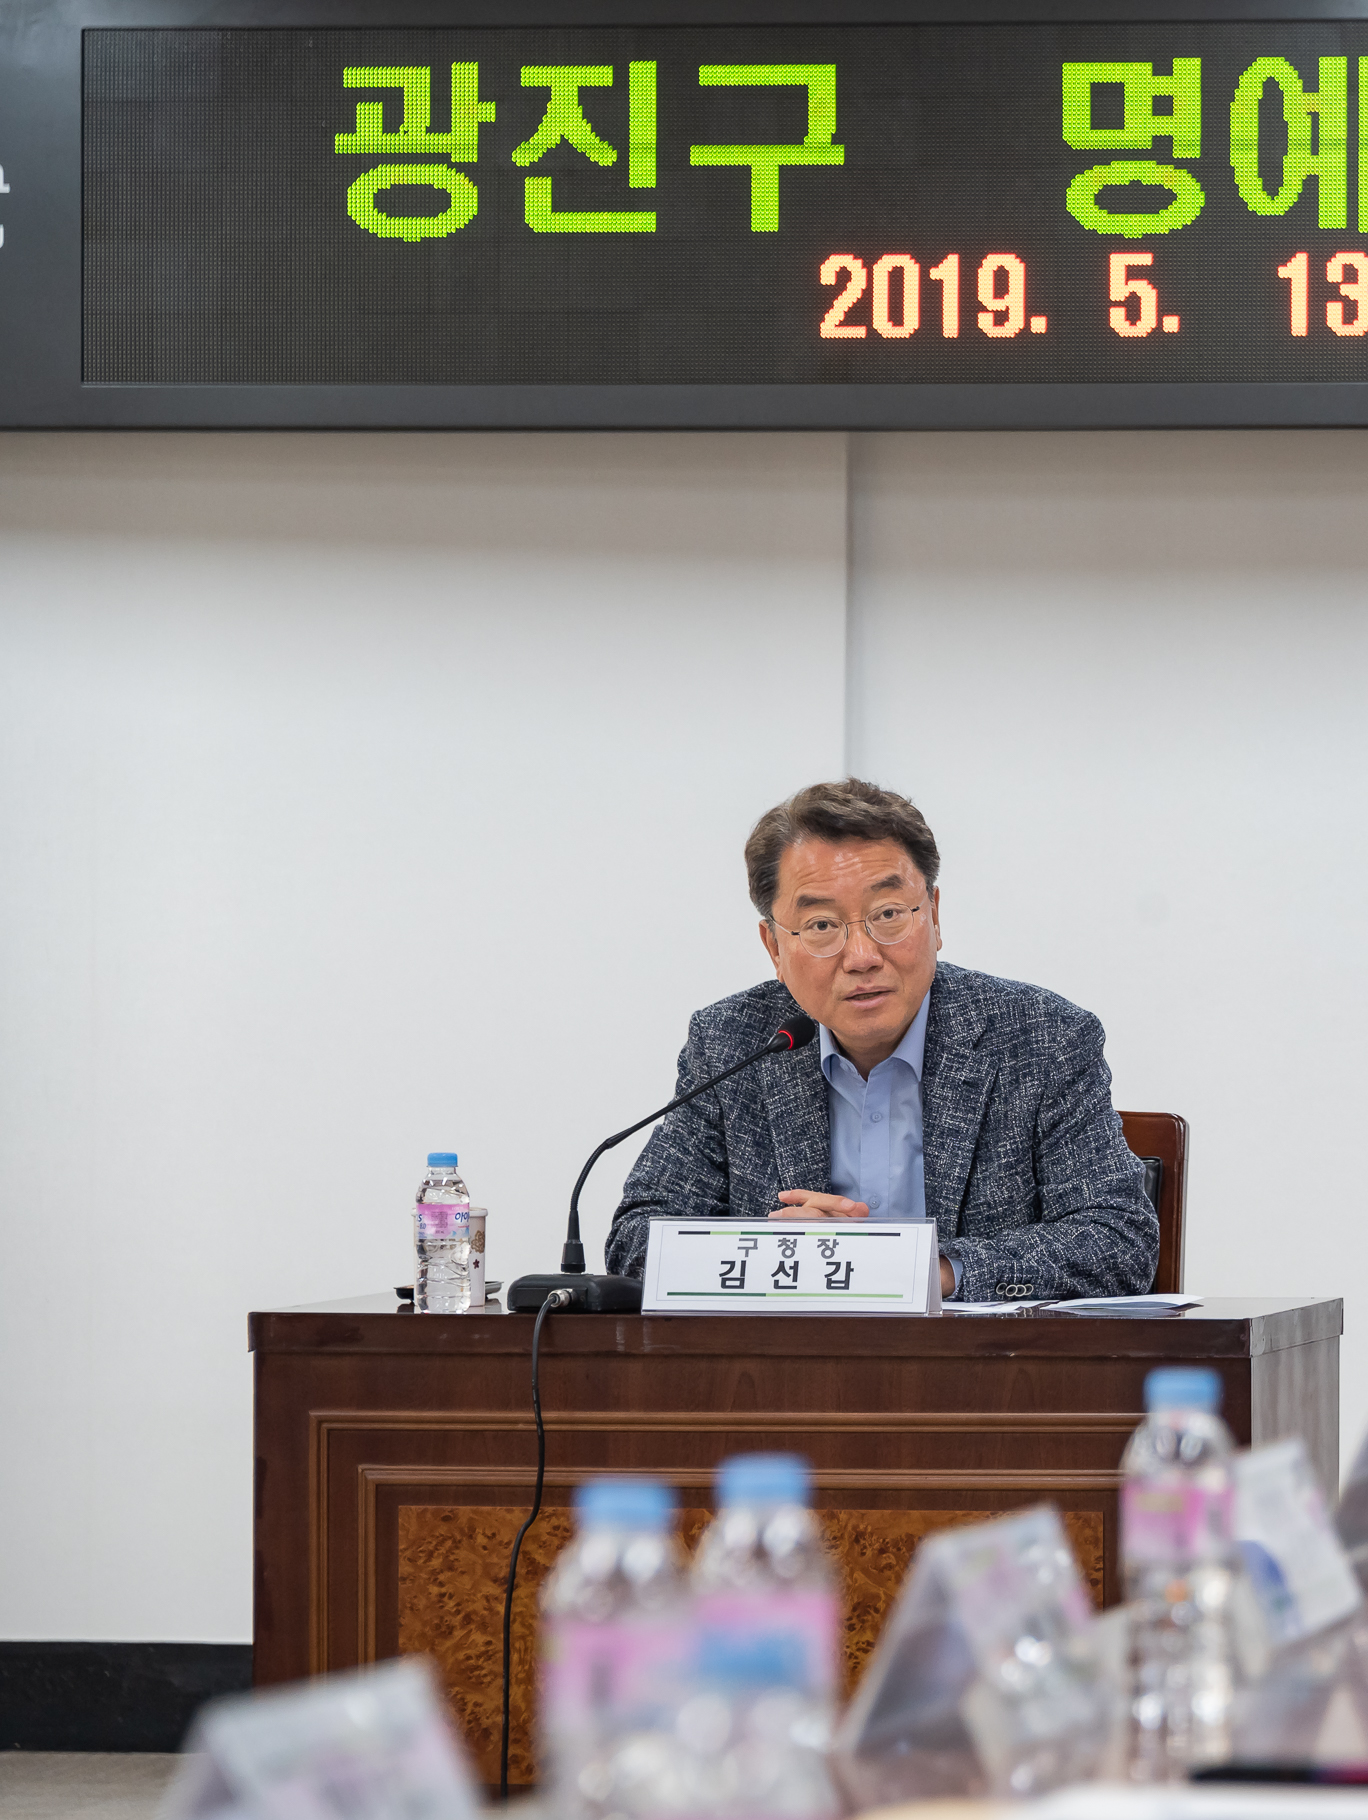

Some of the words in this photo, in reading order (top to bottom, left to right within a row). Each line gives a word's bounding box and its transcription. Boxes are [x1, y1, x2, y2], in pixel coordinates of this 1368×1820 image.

[334, 60, 846, 243] 광진구
[818, 252, 1048, 339] 2019.
[1108, 252, 1180, 339] 5.
